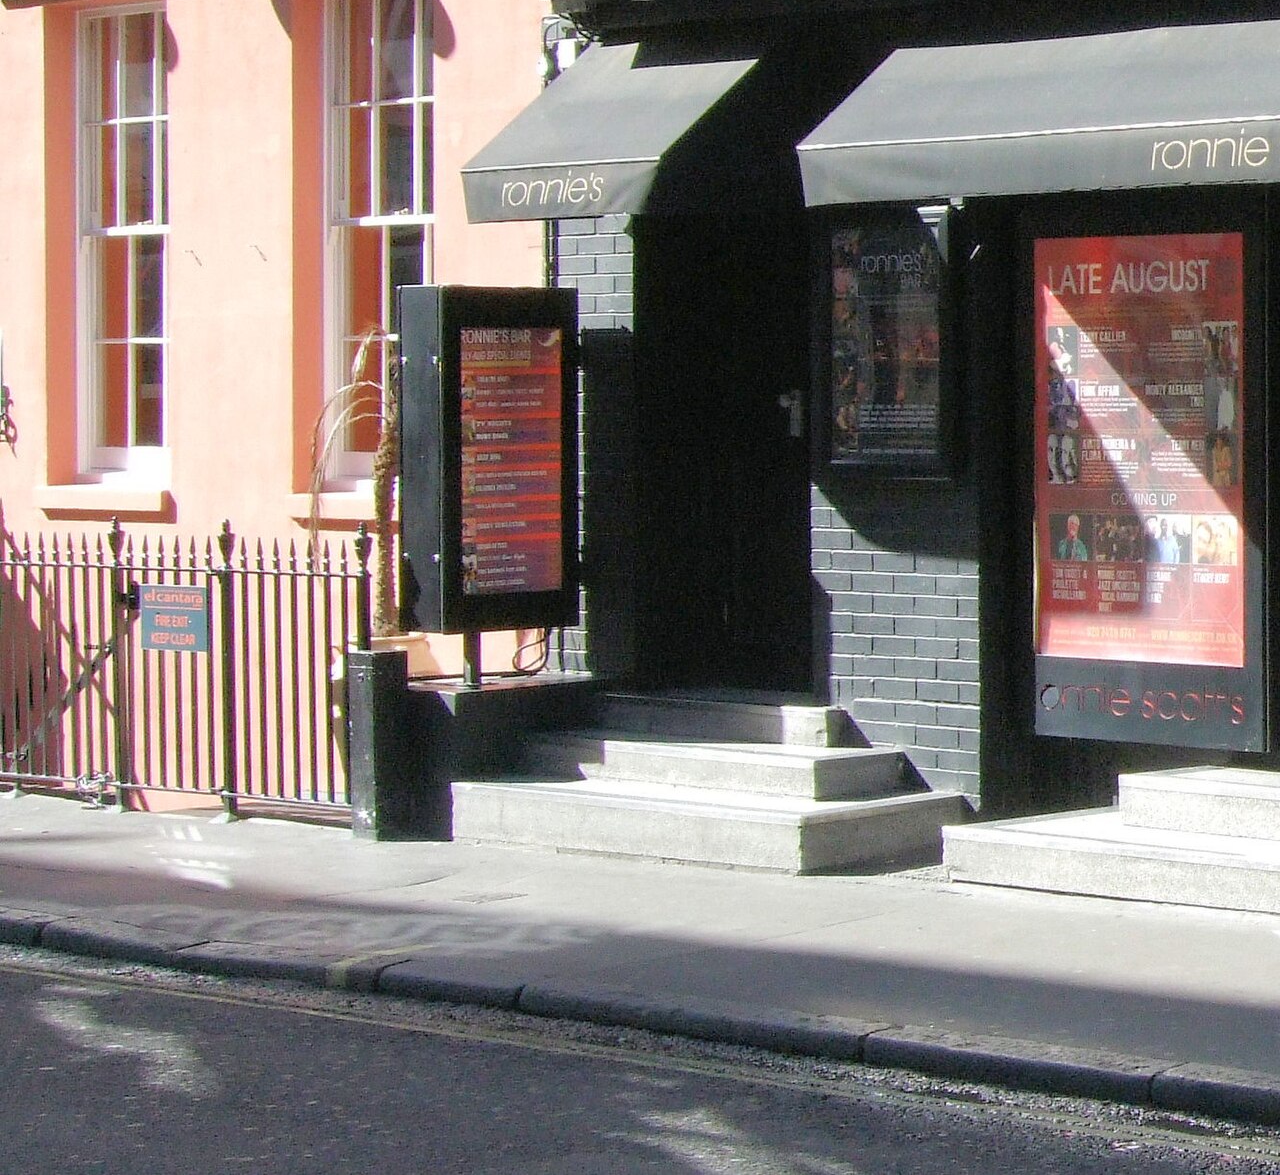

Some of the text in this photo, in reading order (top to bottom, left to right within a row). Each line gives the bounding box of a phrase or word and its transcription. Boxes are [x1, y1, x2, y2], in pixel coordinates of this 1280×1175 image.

[1151, 127, 1270, 171] ronnie
[501, 170, 604, 207] ronnie's
[1048, 259, 1210, 296] LATE AUGUST
[1111, 492, 1178, 507] COMING UP
